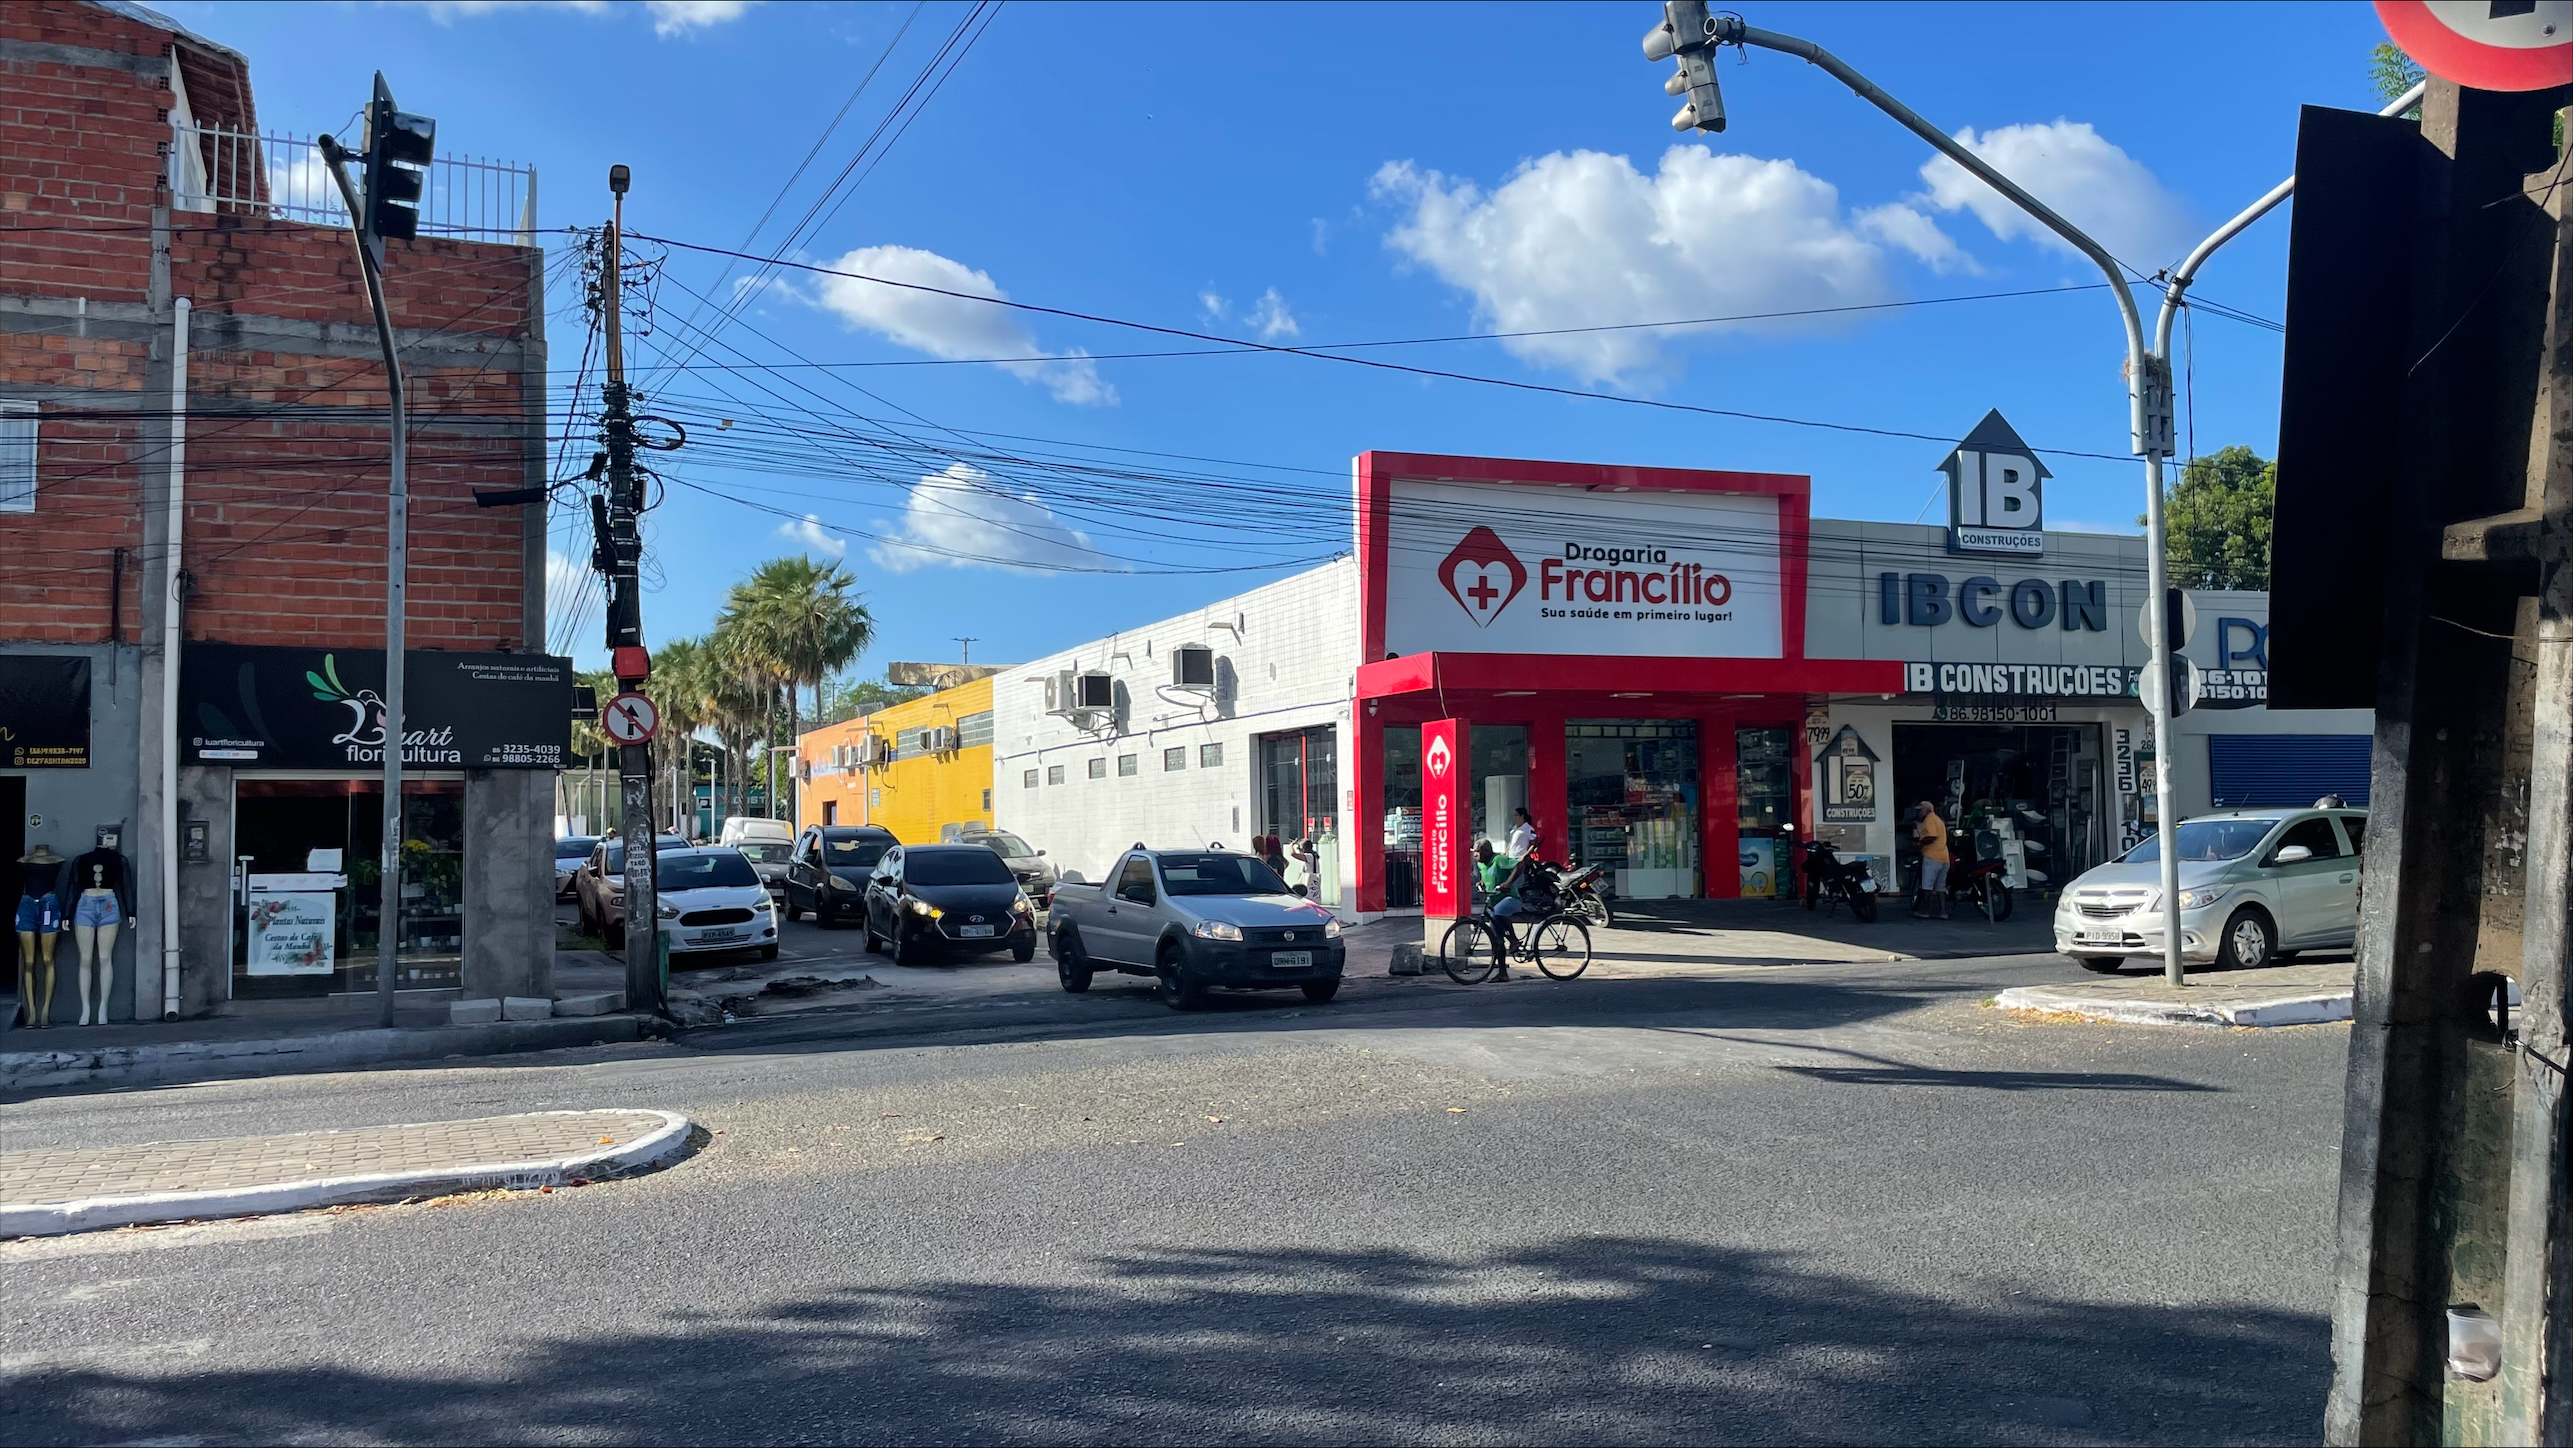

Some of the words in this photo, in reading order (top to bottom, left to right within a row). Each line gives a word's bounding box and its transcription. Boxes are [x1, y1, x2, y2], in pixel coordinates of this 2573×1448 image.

[1957, 450, 2039, 528] IB
[1962, 533, 2041, 548] CONSTRUÇÕES
[1565, 542, 1666, 566] Drogaria
[1541, 558, 1731, 606] Francílio
[1880, 572, 2107, 631] IBCON
[1541, 607, 1565, 618] Sua
[1570, 607, 1609, 619] saúde
[1614, 611, 1632, 619] em
[1637, 609, 1690, 621] primeiro
[1695, 610, 1732, 623] lugar!
[458, 662, 490, 672] Arranjos
[490, 664, 520, 673] naturais
[526, 665, 560, 674] artificiais
[1940, 664, 2121, 696] CONSTRUÇÕES
[346, 745, 461, 763] floriultura
[503, 744, 561, 754] 3235-4039
[502, 754, 560, 764] 98805-2266
[1435, 794, 1448, 893] Francílio
[295, 915, 325, 926] Naturais
